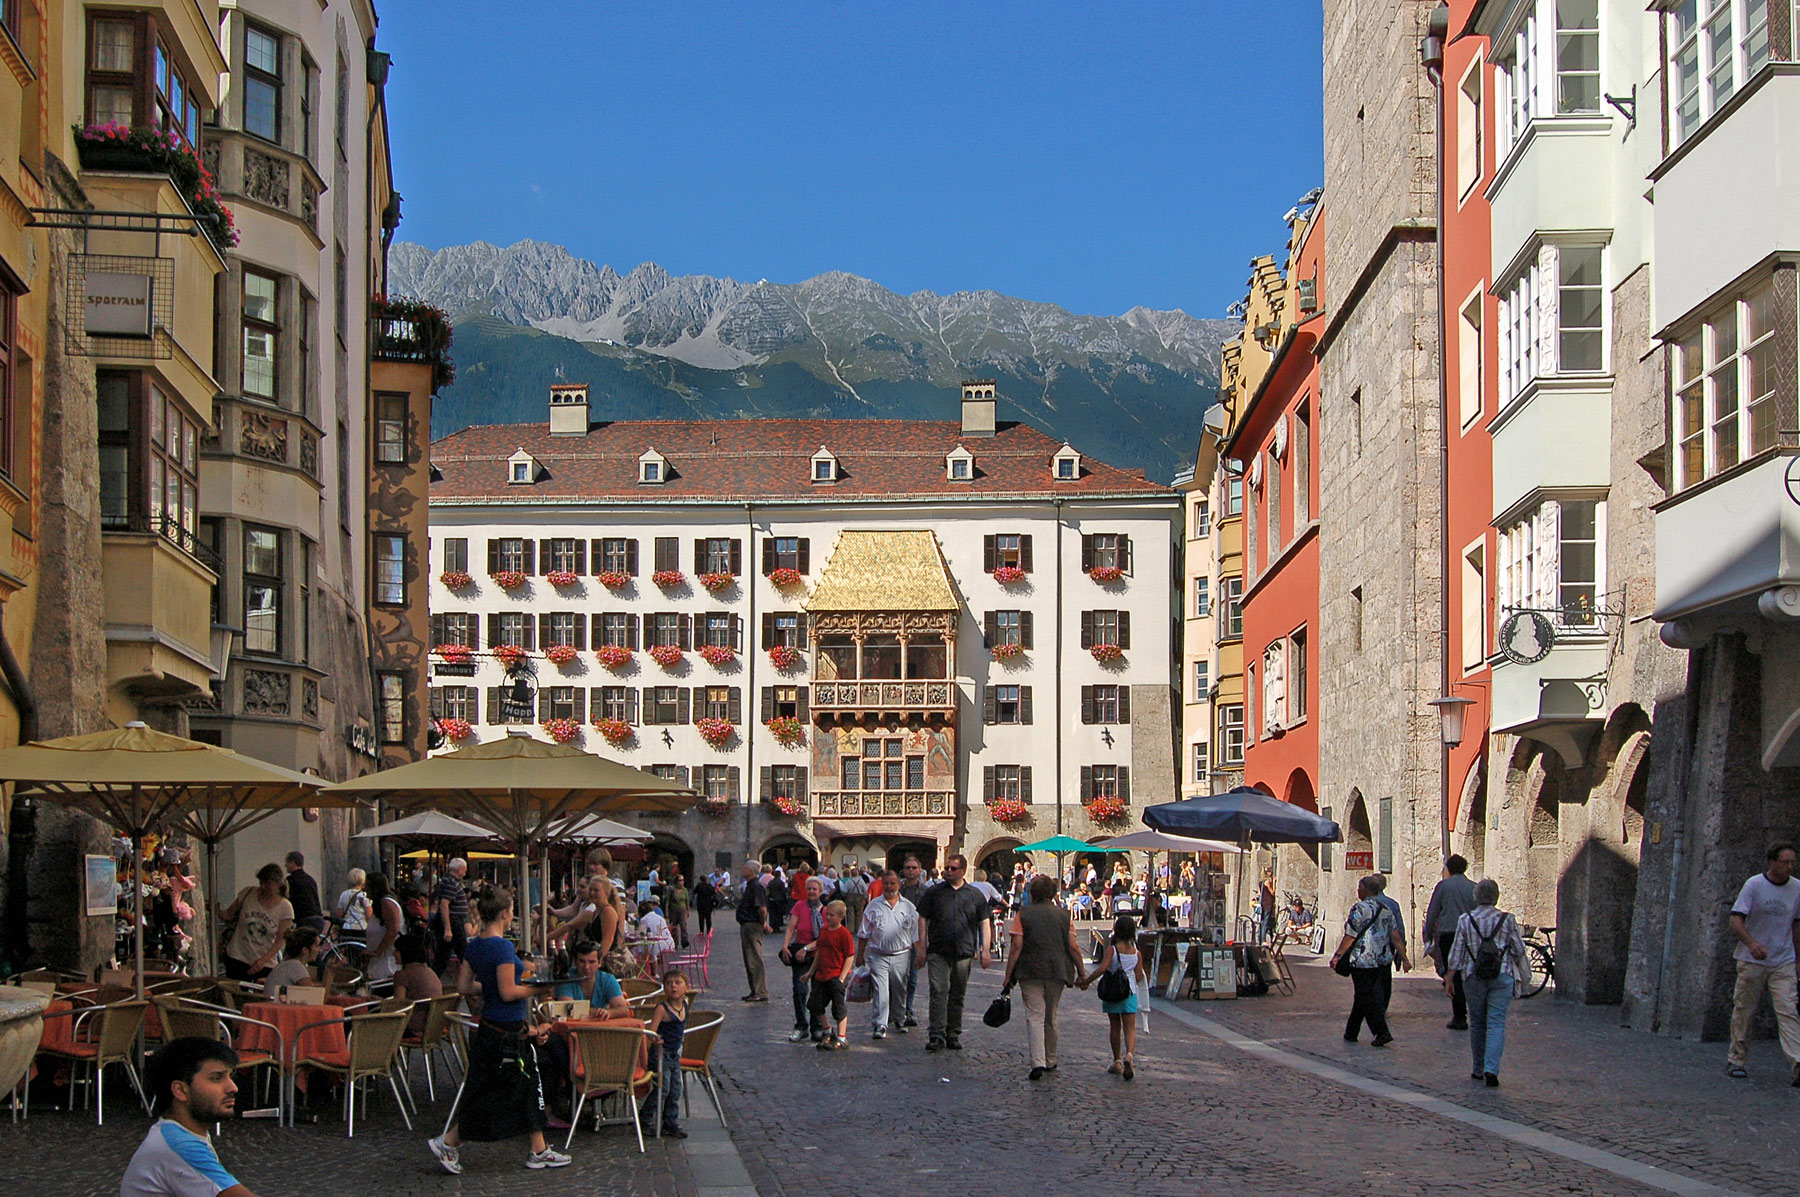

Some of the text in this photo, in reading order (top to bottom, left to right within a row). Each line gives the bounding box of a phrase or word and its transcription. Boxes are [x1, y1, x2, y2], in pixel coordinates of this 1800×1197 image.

[436, 665, 473, 675] Weinhaus
[505, 705, 533, 718] Happ
[1346, 855, 1362, 866] WC
